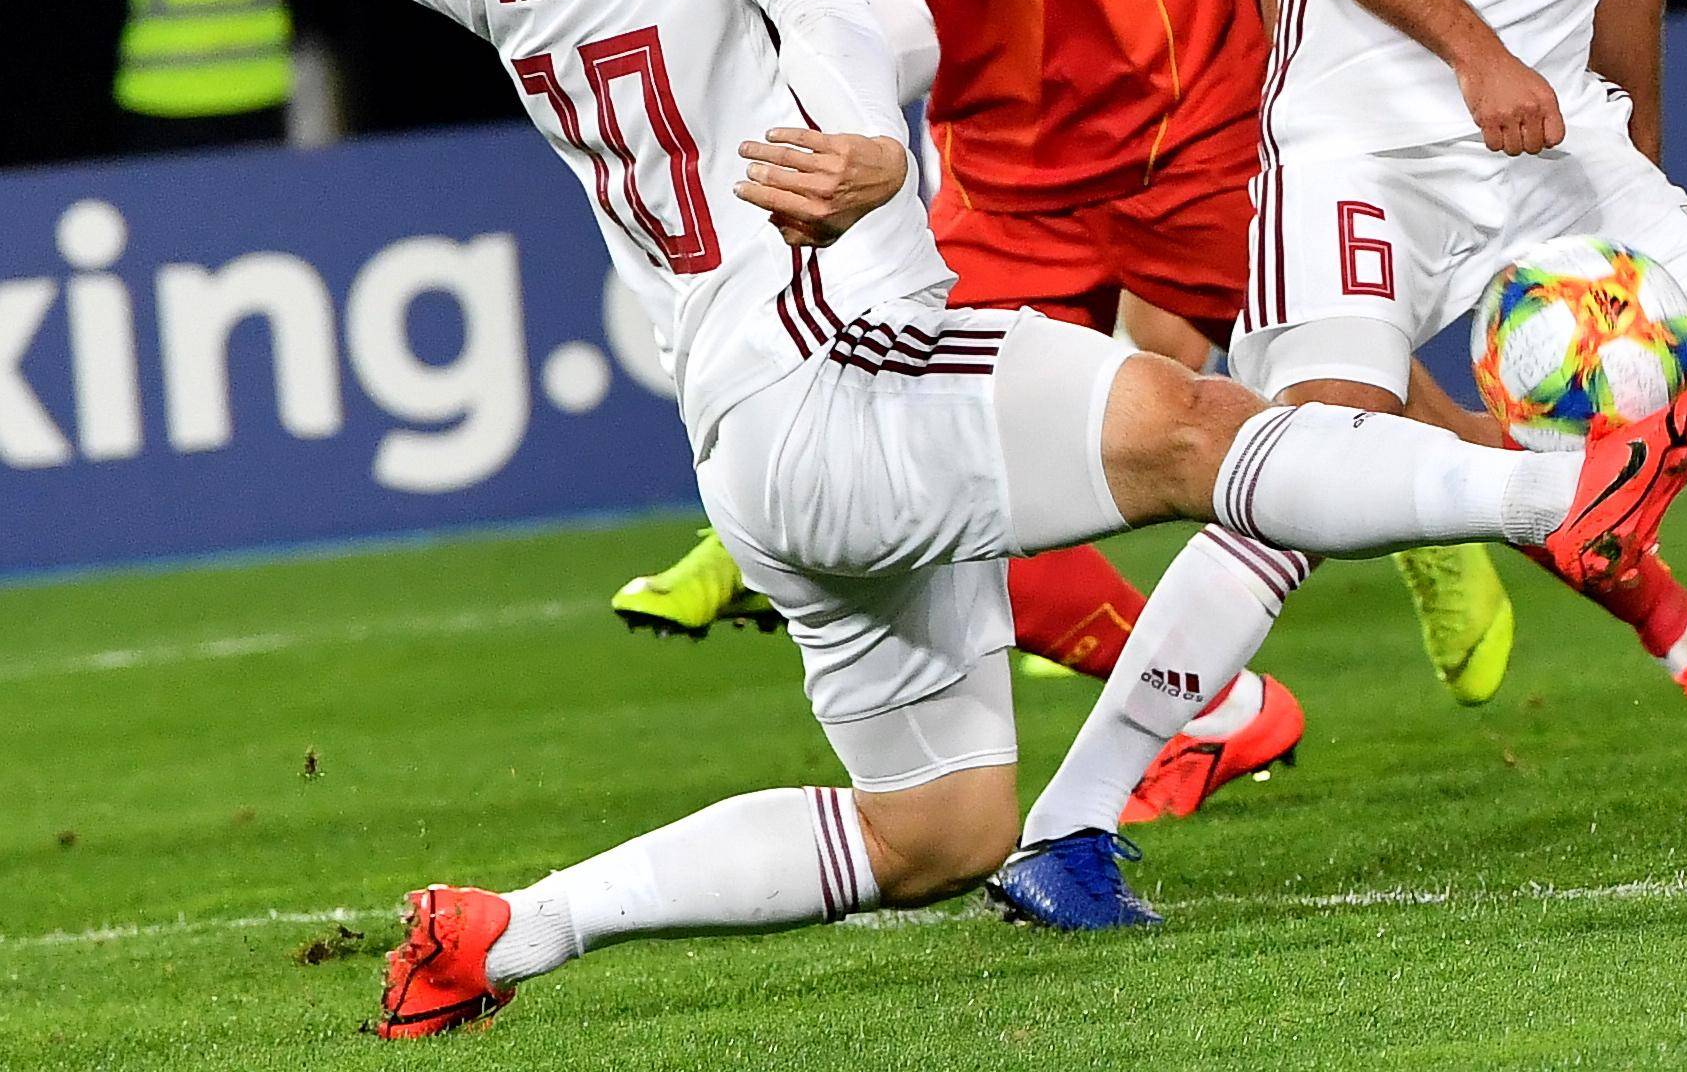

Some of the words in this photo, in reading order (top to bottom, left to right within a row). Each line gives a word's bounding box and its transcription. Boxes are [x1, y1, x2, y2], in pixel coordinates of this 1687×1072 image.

[511, 24, 723, 276] 10
[1336, 200, 1396, 302] 6
[1140, 671, 1204, 703] adidas
